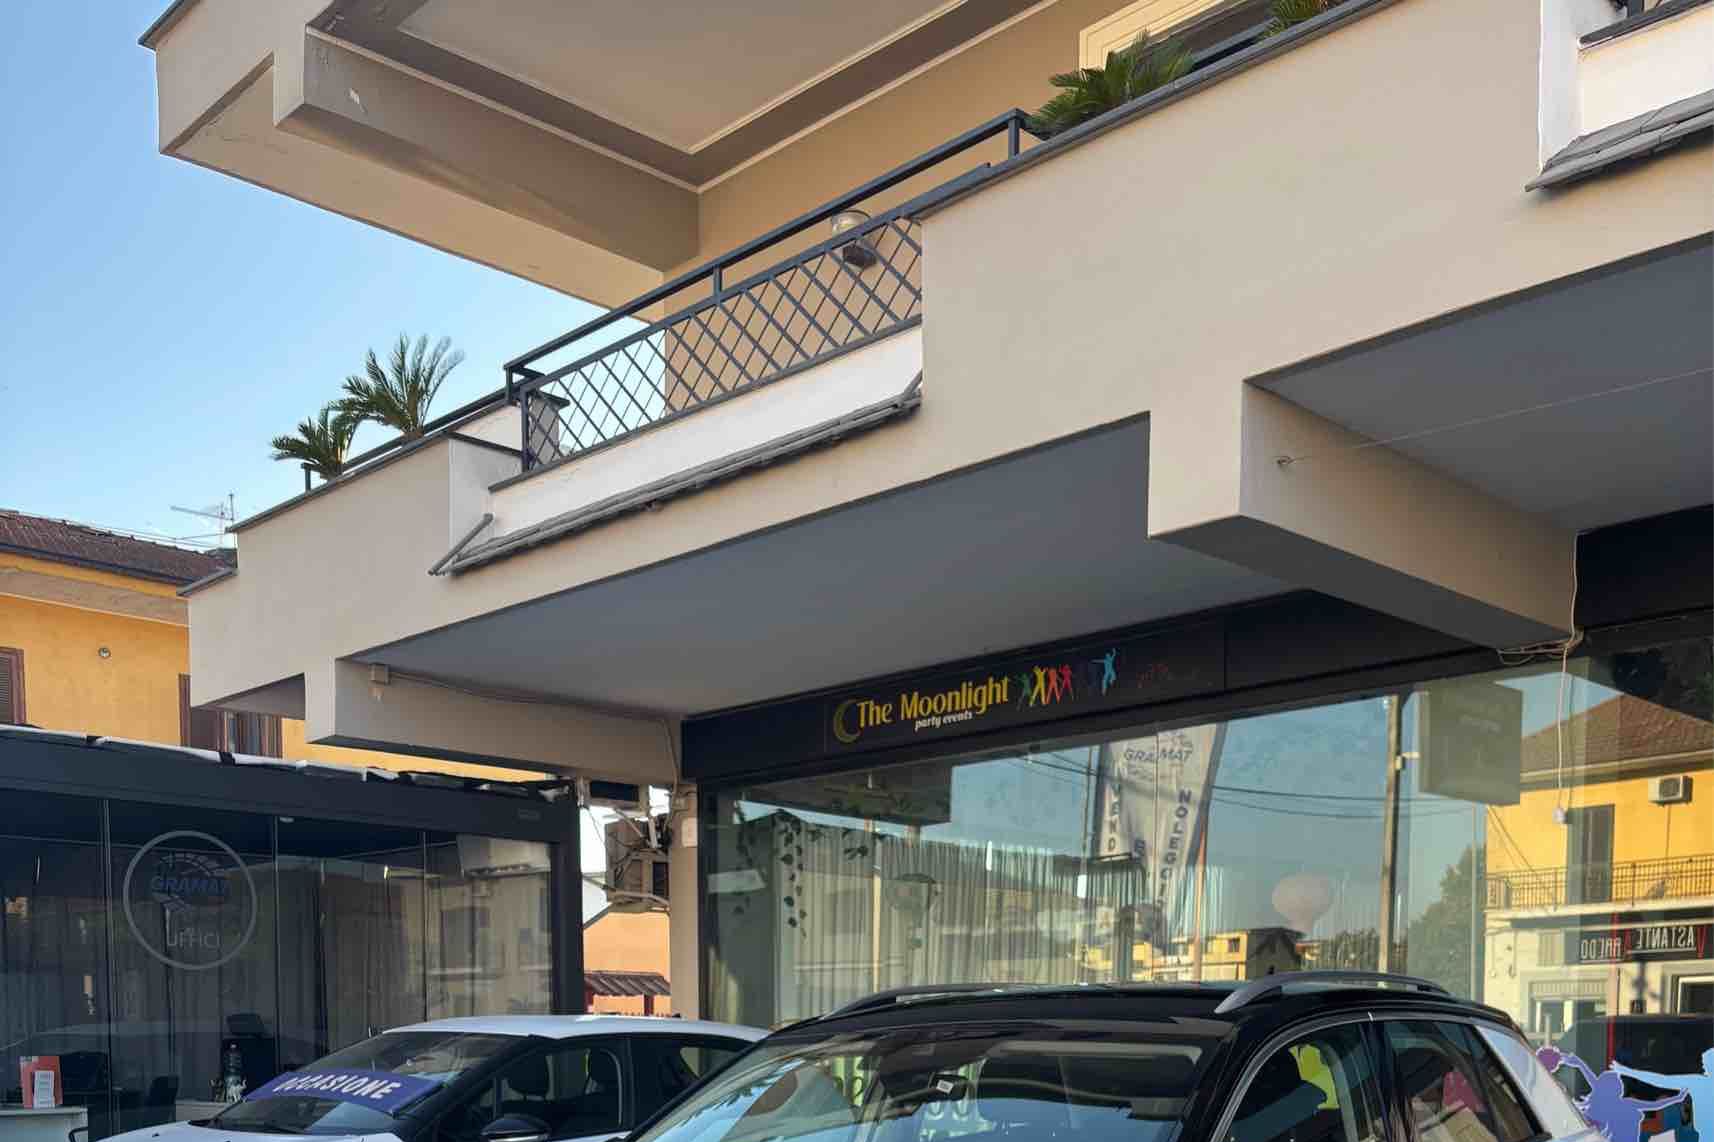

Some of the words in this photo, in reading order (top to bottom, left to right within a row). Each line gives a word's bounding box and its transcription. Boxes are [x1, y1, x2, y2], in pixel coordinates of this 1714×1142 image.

[856, 700, 893, 728] The
[900, 675, 1010, 721] Moonlight
[914, 715, 941, 732] party
[943, 709, 973, 725] events
